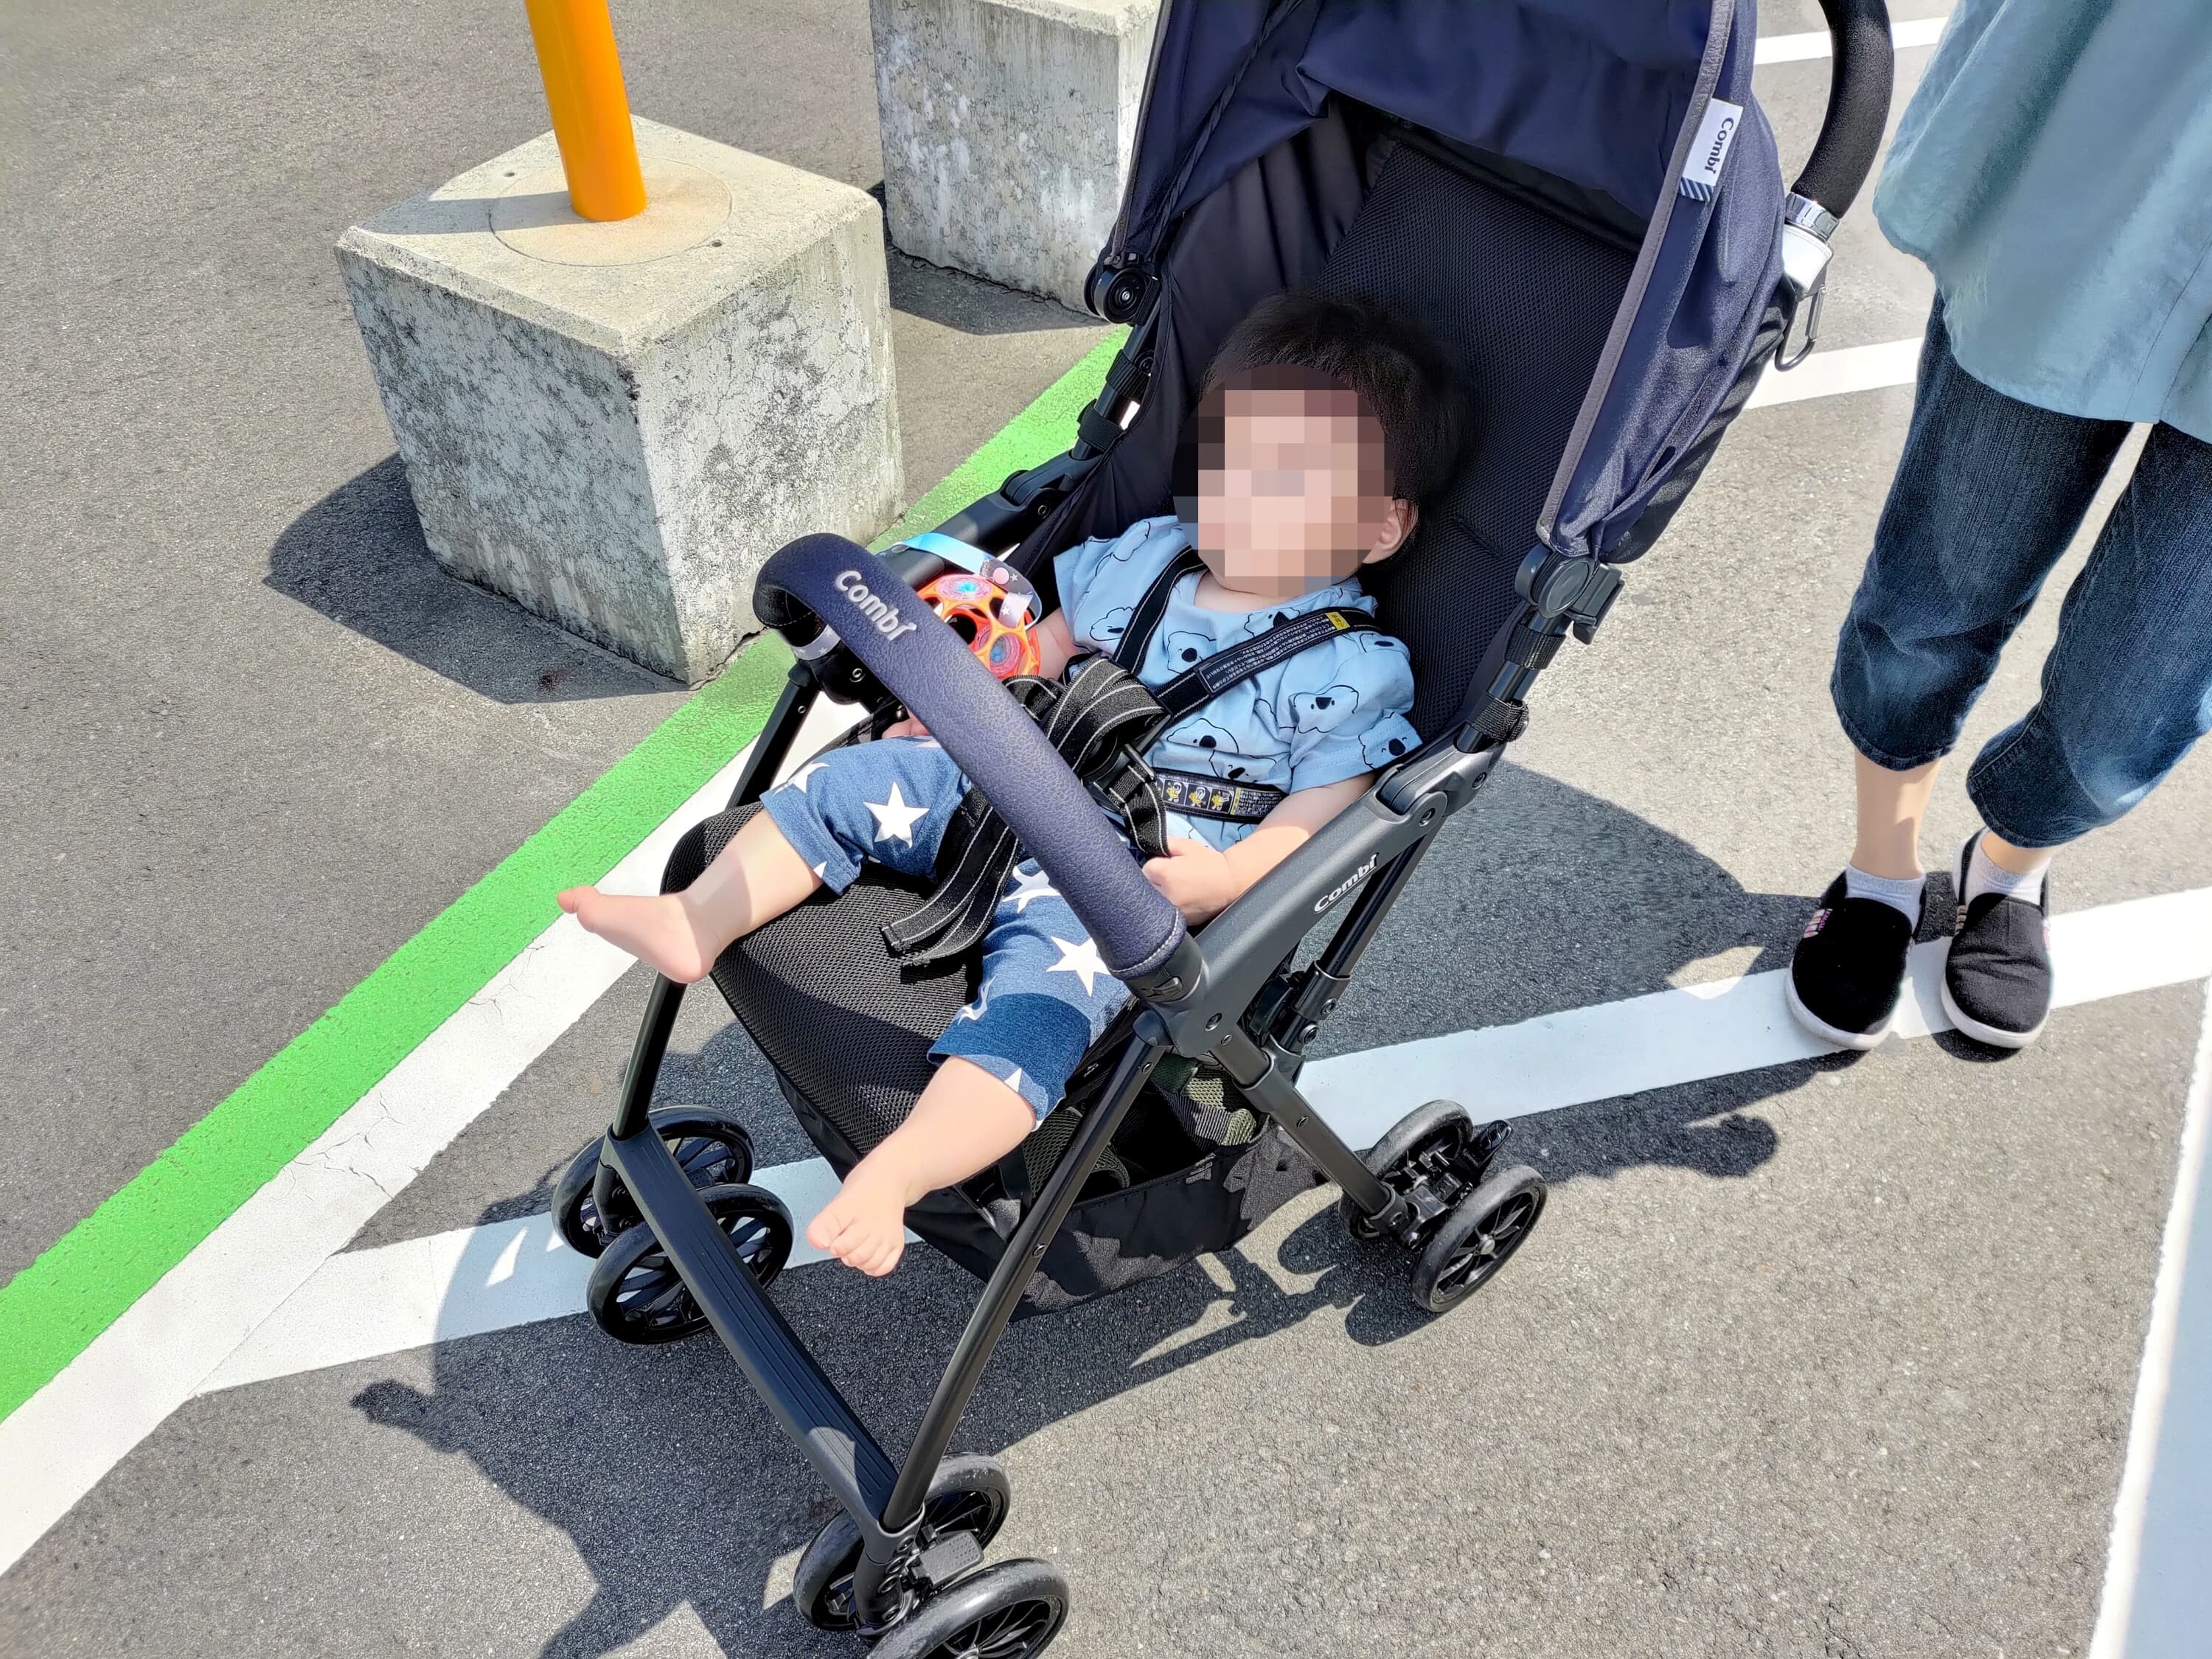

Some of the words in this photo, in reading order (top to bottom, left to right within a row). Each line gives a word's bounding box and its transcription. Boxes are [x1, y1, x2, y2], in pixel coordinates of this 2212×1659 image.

[1704, 117, 1734, 175] Combi
[835, 570, 917, 641] Combi
[1314, 853, 1378, 913] Combi
